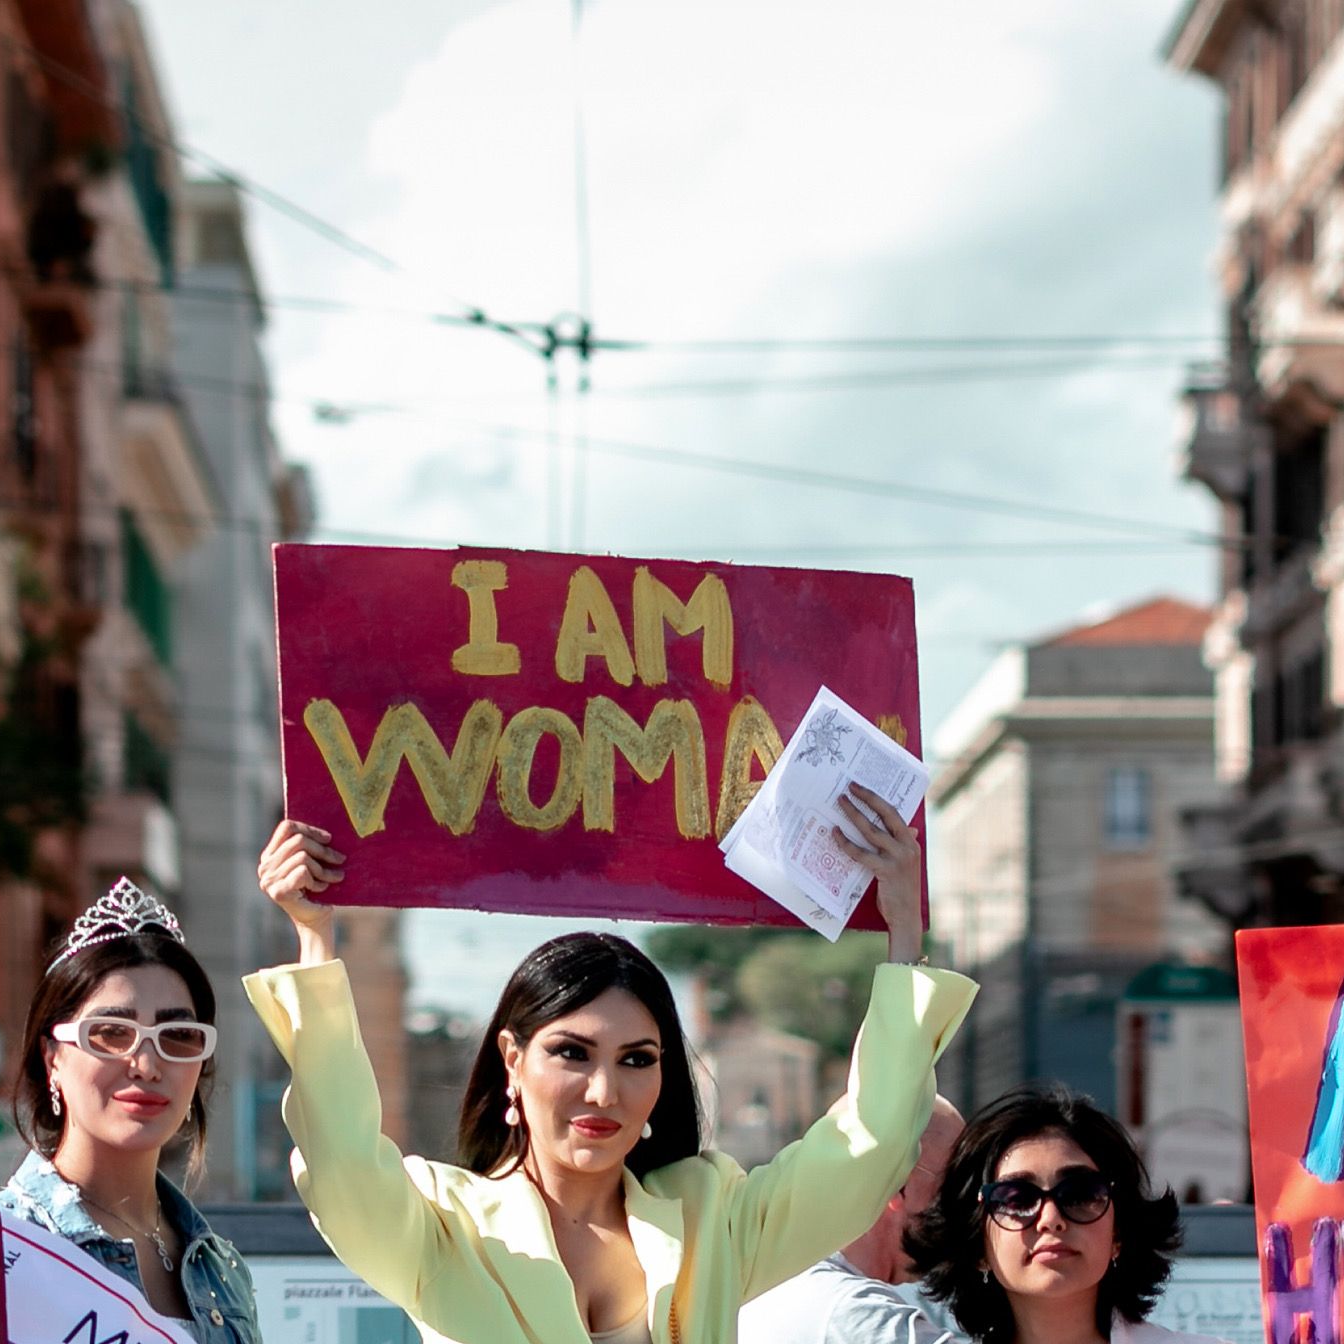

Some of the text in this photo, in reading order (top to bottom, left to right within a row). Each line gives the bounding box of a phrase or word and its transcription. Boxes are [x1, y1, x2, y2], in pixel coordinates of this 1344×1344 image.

[451, 560, 734, 690] I AM
[303, 694, 908, 840] WOMA
